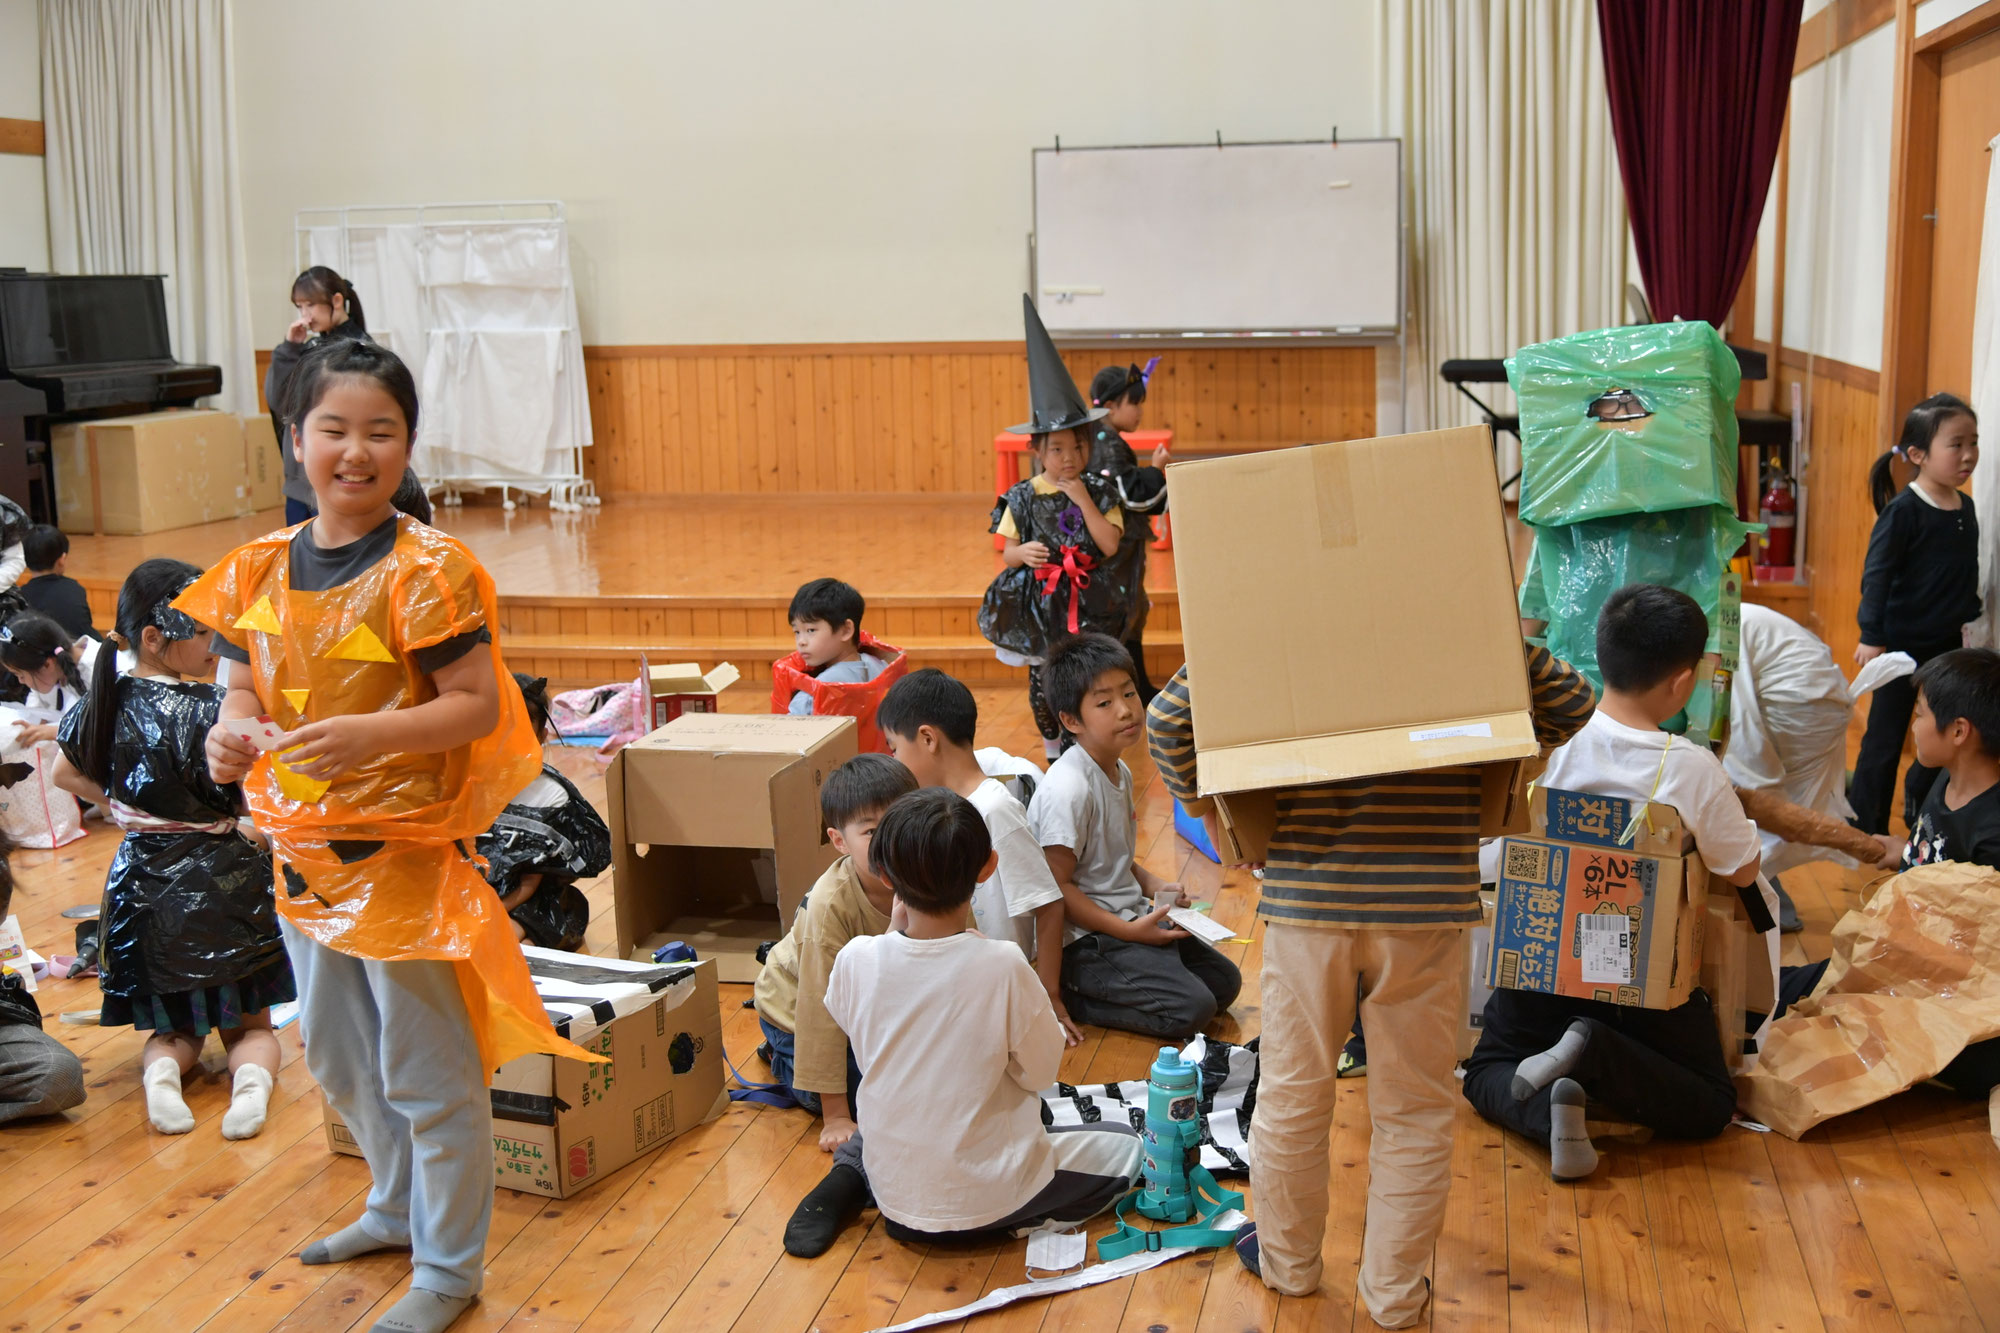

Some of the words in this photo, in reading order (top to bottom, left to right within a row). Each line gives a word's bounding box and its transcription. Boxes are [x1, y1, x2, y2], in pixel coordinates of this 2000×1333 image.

[1557, 796, 1566, 835] キャンペーン
[1577, 798, 1611, 838] 対
[1605, 857, 1629, 895] 2L
[1630, 860, 1643, 882] PET
[1512, 883, 1527, 938] キャンペーン
[581, 1081, 591, 1108] 16枚
[493, 1138, 543, 1160] サラダせん
[534, 1178, 554, 1191] 16枚
